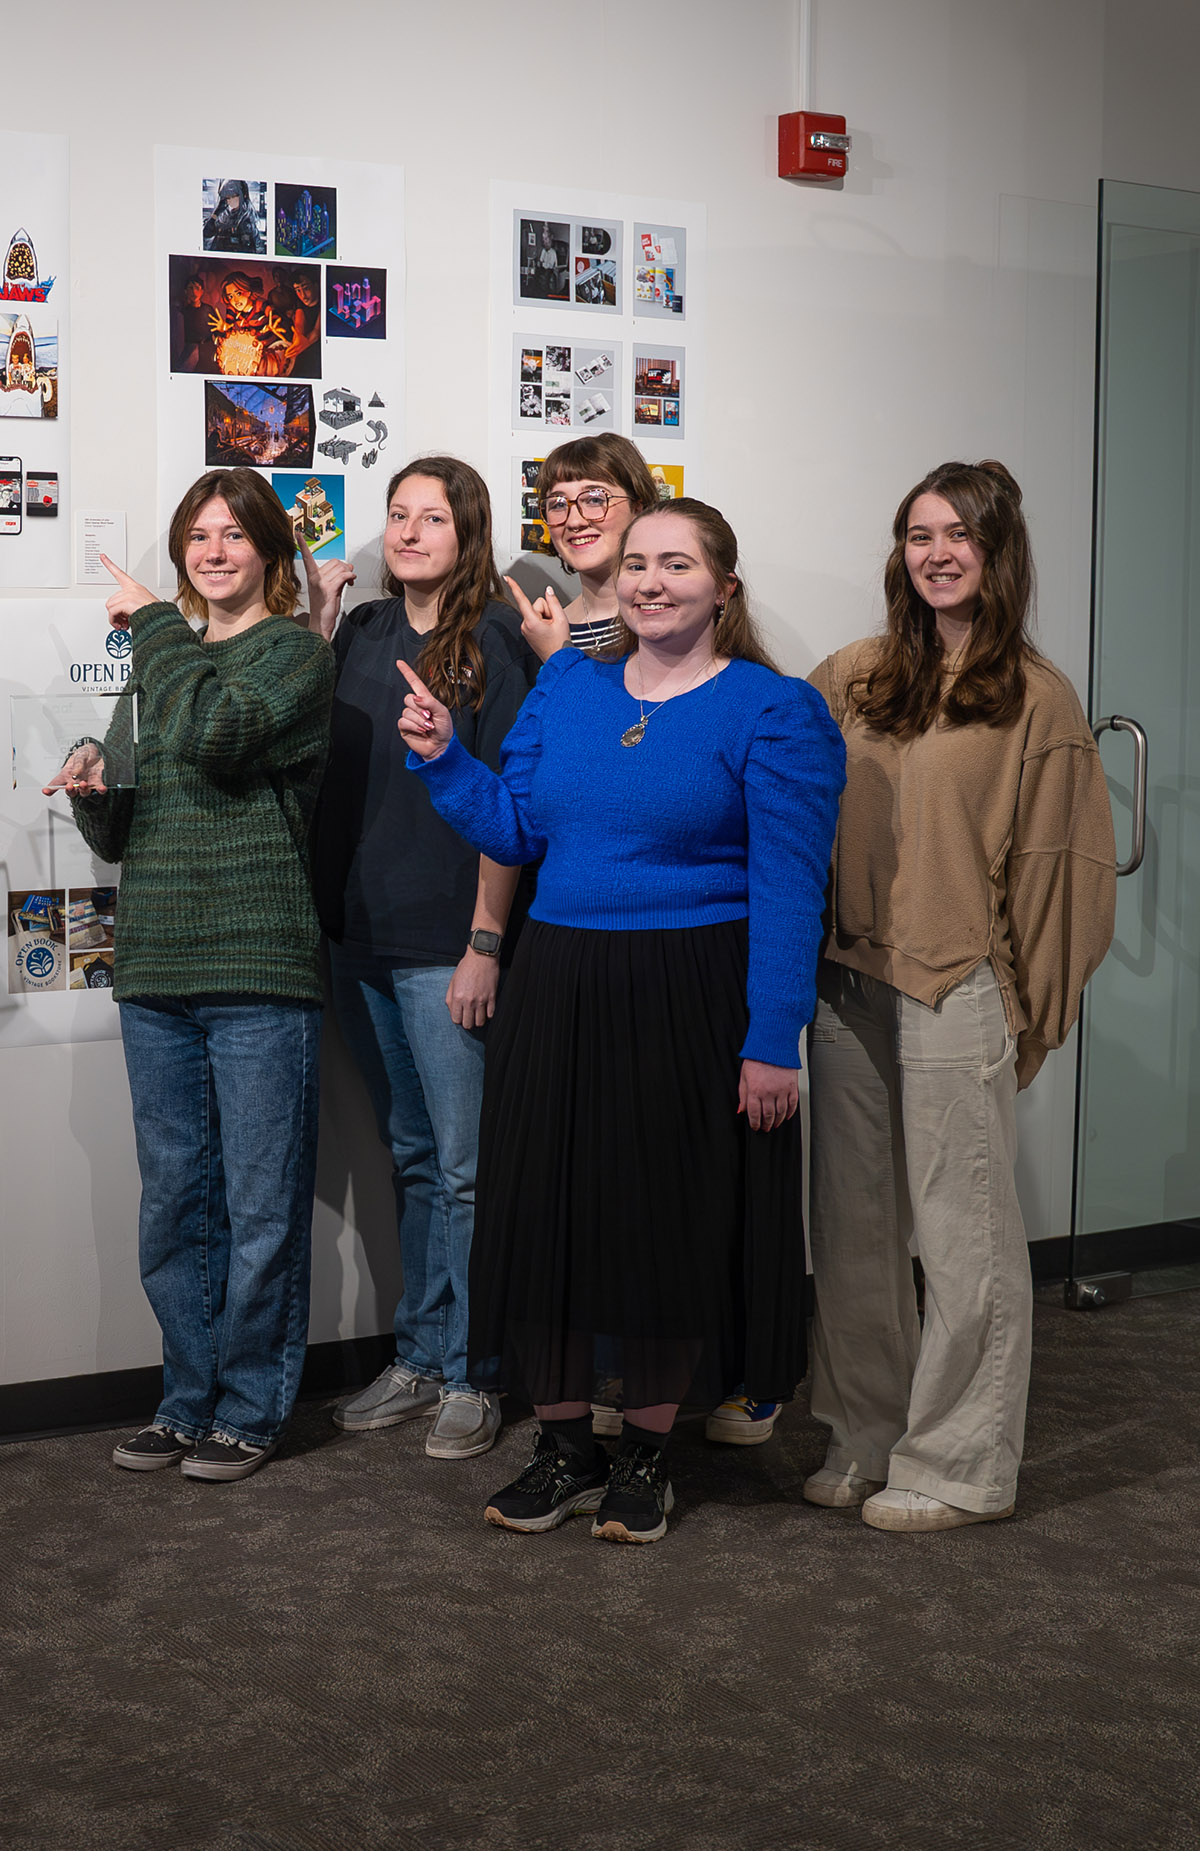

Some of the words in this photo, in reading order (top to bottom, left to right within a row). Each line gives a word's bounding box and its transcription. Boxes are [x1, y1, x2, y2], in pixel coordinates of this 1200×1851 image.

[828, 158, 843, 168] FIRE
[0, 286, 46, 303] JAWS
[69, 663, 115, 683] OPEN
[15, 941, 33, 966] OPEN
[33, 937, 58, 951] BOOK
[23, 975, 44, 988] VINTAGE
